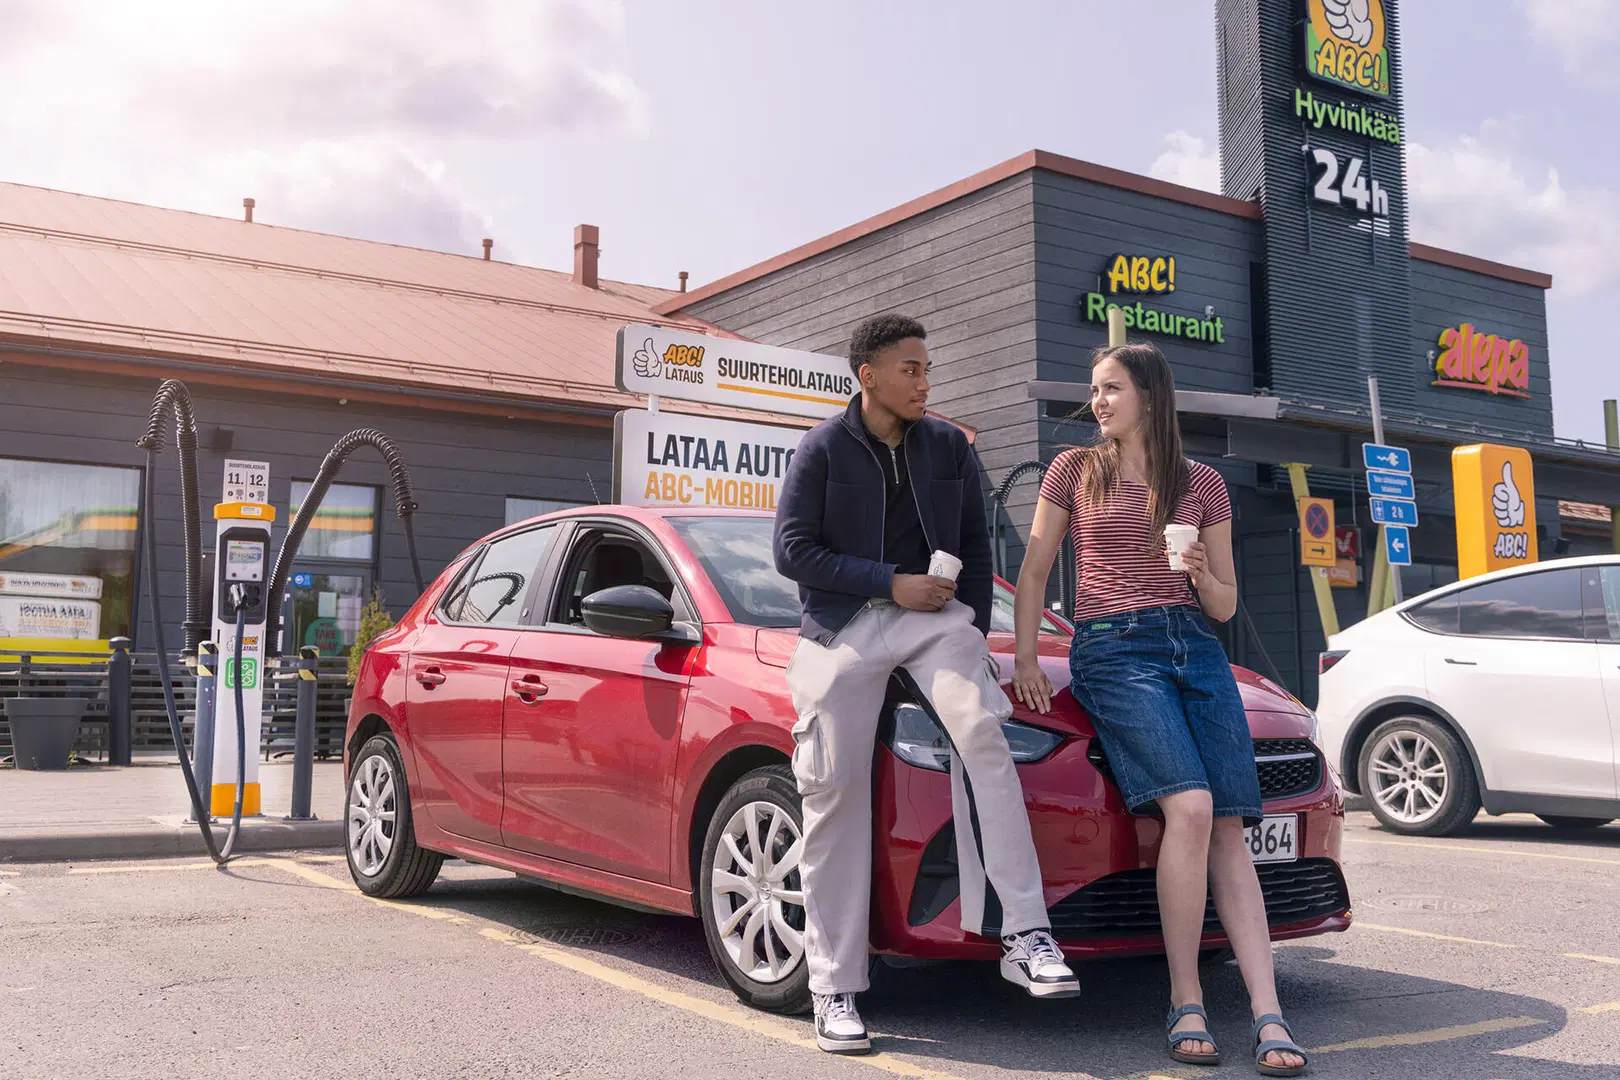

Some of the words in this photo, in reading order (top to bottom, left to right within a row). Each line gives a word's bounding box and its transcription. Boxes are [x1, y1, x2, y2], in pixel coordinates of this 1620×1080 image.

[1314, 38, 1382, 91] ABC!
[1295, 88, 1400, 144] Hyvinkää
[1312, 148, 1389, 216] 24h
[1107, 255, 1176, 293] ABC!
[663, 344, 705, 367] ABC!
[1435, 323, 1529, 395] alepa
[665, 367, 704, 384] LATAUS
[717, 357, 853, 395] SUURTEHOLATAUS
[647, 431, 729, 473] LATAA
[228, 472, 244, 485] 11.
[249, 474, 266, 487] 12.
[1494, 532, 1529, 559] ABC!
